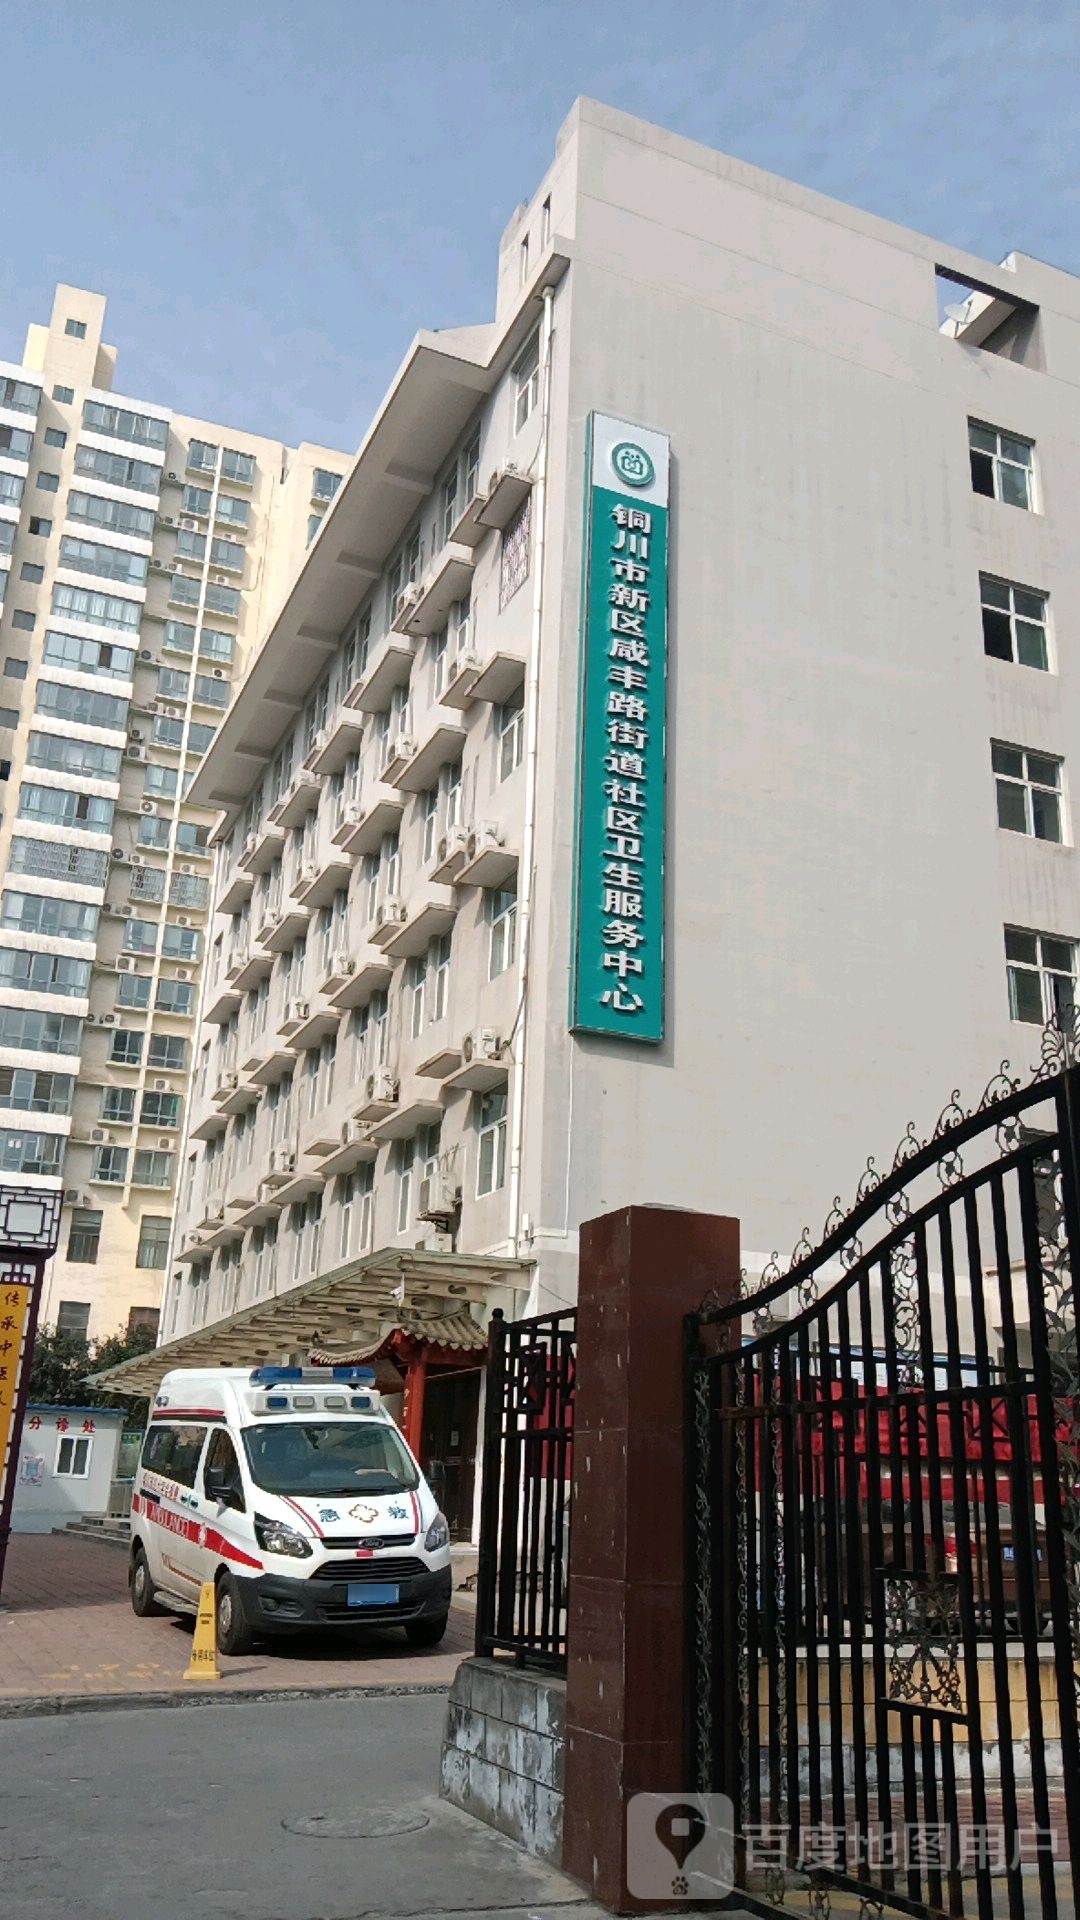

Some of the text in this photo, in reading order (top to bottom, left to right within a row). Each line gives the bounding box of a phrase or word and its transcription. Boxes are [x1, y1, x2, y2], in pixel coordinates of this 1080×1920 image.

[600, 503, 651, 1012] 铜川市新区咸丰路街道社区卫生服务中心
[28, 1415, 96, 1433] 分诊处
